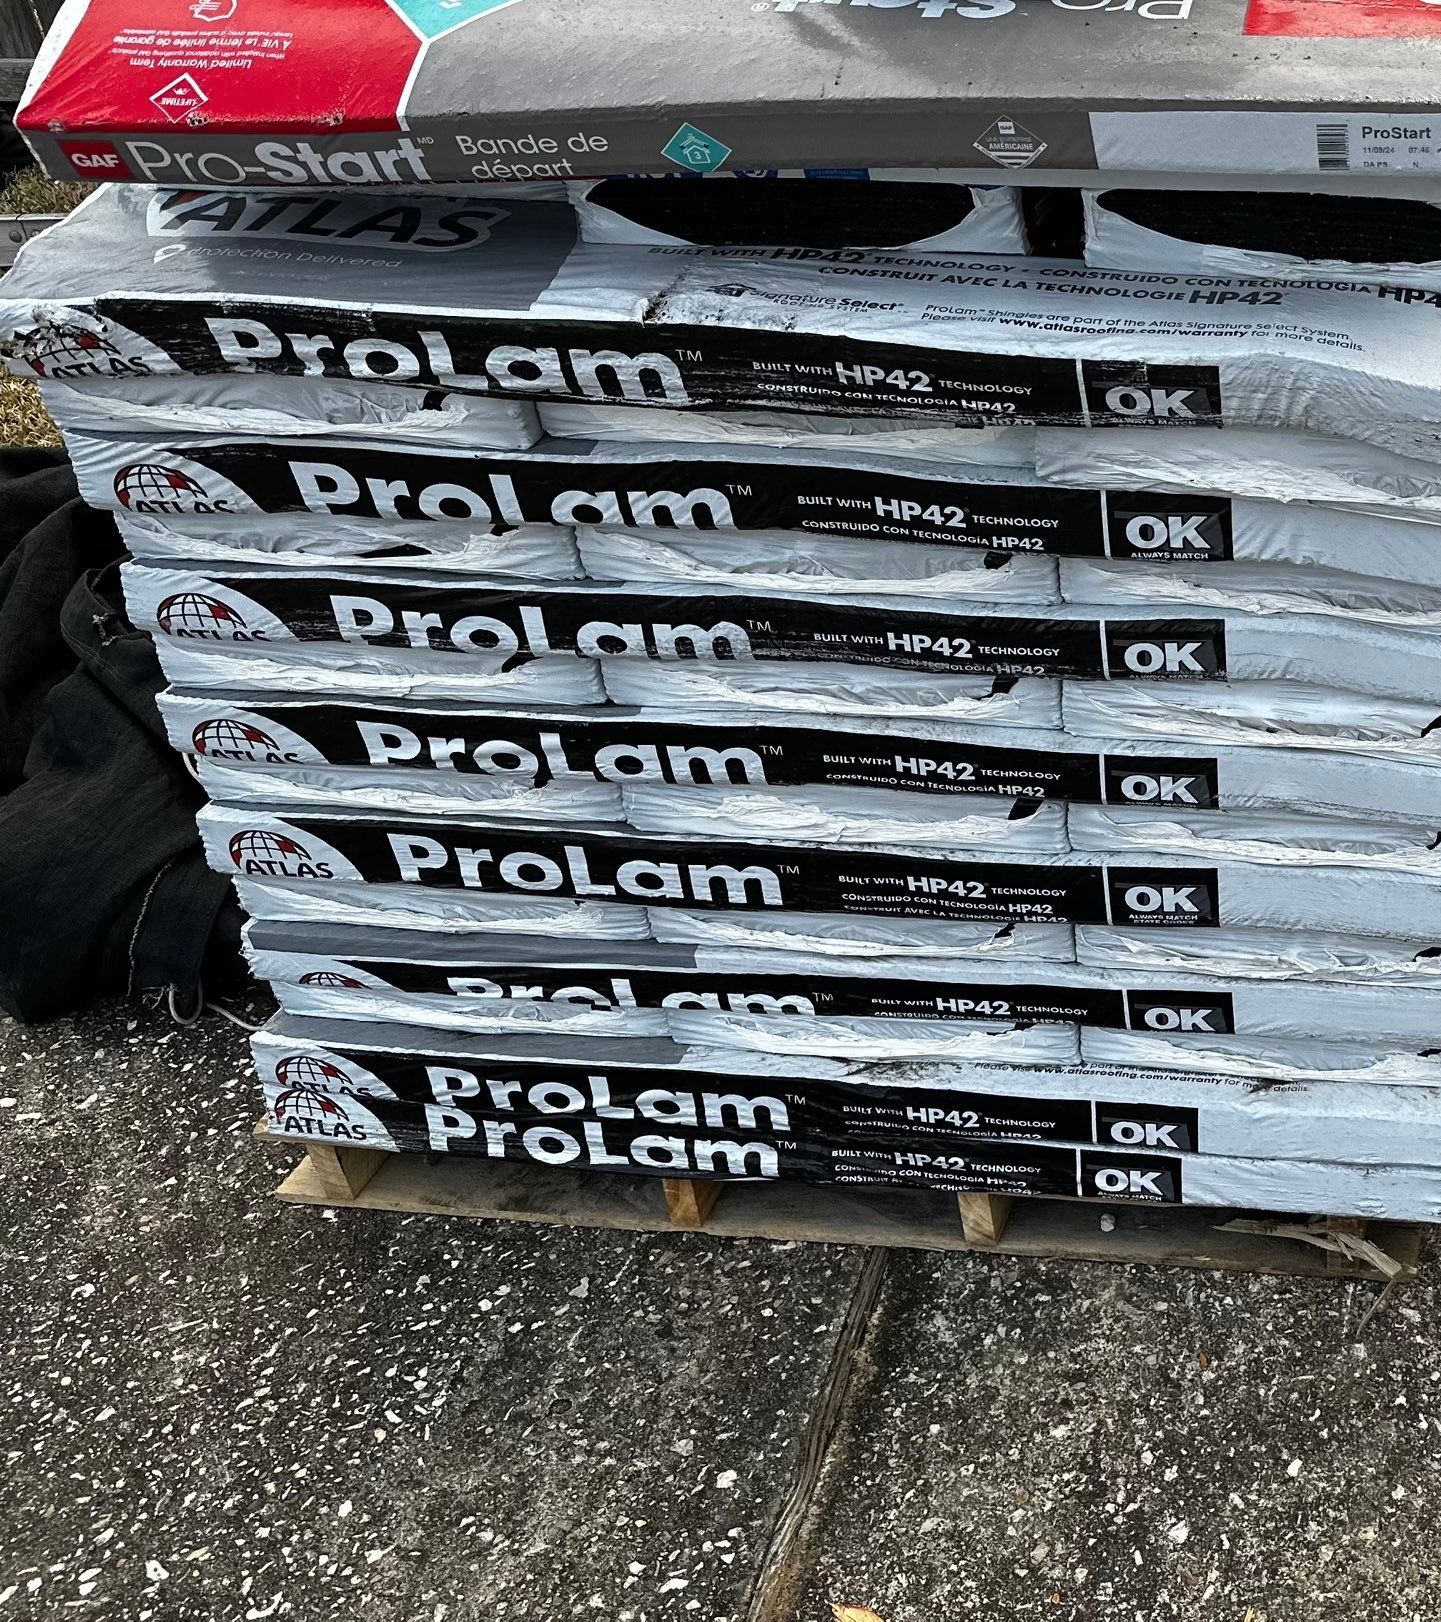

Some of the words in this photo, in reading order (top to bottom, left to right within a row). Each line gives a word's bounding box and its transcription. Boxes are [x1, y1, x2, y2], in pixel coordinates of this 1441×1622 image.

[156, 38, 172, 47] de
[245, 38, 258, 46] Le
[129, 58, 155, 68] Term
[157, 57, 208, 69] Warranty
[209, 58, 253, 70] Limited
[161, 97, 198, 107] LIFETIME
[455, 135, 556, 155] Bande
[566, 132, 609, 153] de
[1362, 126, 1431, 139] ProStart
[71, 151, 120, 169] GAF
[471, 158, 574, 180] départ
[161, 190, 502, 248] ATLAS
[296, 251, 403, 269] Delivered
[711, 248, 767, 257] WITH
[873, 256, 1015, 273] TECHNOLOGY
[1039, 268, 1179, 285] CONSTRUIDO
[1184, 278, 1232, 287] CON
[818, 265, 938, 282] CONSTRUIT
[940, 274, 996, 288] AVEC
[1003, 279, 1029, 290] LA
[1036, 281, 1186, 302] TECHNOLOGIE
[920, 312, 967, 322] Please
[970, 315, 998, 323] visit
[1250, 329, 1270, 338] for
[1274, 331, 1313, 342] more
[988, 308, 1043, 320] Shingles
[1046, 313, 1071, 321] are
[1072, 315, 1102, 325] part
[1106, 318, 1121, 326] of
[1123, 319, 1147, 328] the
[1152, 320, 1183, 328] Atlas
[1186, 321, 1252, 330] Signature
[939, 378, 1033, 396] TECHNOLOGY
[1105, 384, 1199, 419] OK
[797, 495, 834, 506] BUILT
[836, 496, 872, 510] WITH
[972, 513, 1060, 529] TECHNOLOGY
[801, 518, 880, 532] CONSTRUIDO
[882, 525, 909, 535] CON
[992, 534, 1045, 551] HP42
[1125, 514, 1209, 550] OK
[814, 631, 848, 643] BUILT
[850, 634, 884, 645] WITH
[978, 645, 1061, 657] TECHNOLOGY
[1123, 640, 1206, 674] OK
[823, 753, 856, 764] BUILT
[859, 755, 892, 767] WITH
[980, 767, 1062, 781] TECHNOLOGY
[901, 779, 926, 788] CON
[1120, 774, 1199, 804] OK
[246, 857, 334, 880] ATLAS
[838, 875, 871, 885] BUILT
[873, 875, 905, 886] WITH
[991, 885, 1067, 897] TECHNOLOGY
[914, 895, 937, 905] CON
[1124, 885, 1199, 913] OK
[1016, 1005, 1089, 1017] TECHNOLOGY
[1144, 1006, 1217, 1032] OK
[284, 1114, 368, 1140] ATLAS
[984, 1116, 1056, 1129] TECHNOLOGY
[1110, 1121, 1180, 1149] OK
[970, 1163, 1042, 1174] TECHNOLOGY
[1095, 1168, 1163, 1194] OK
